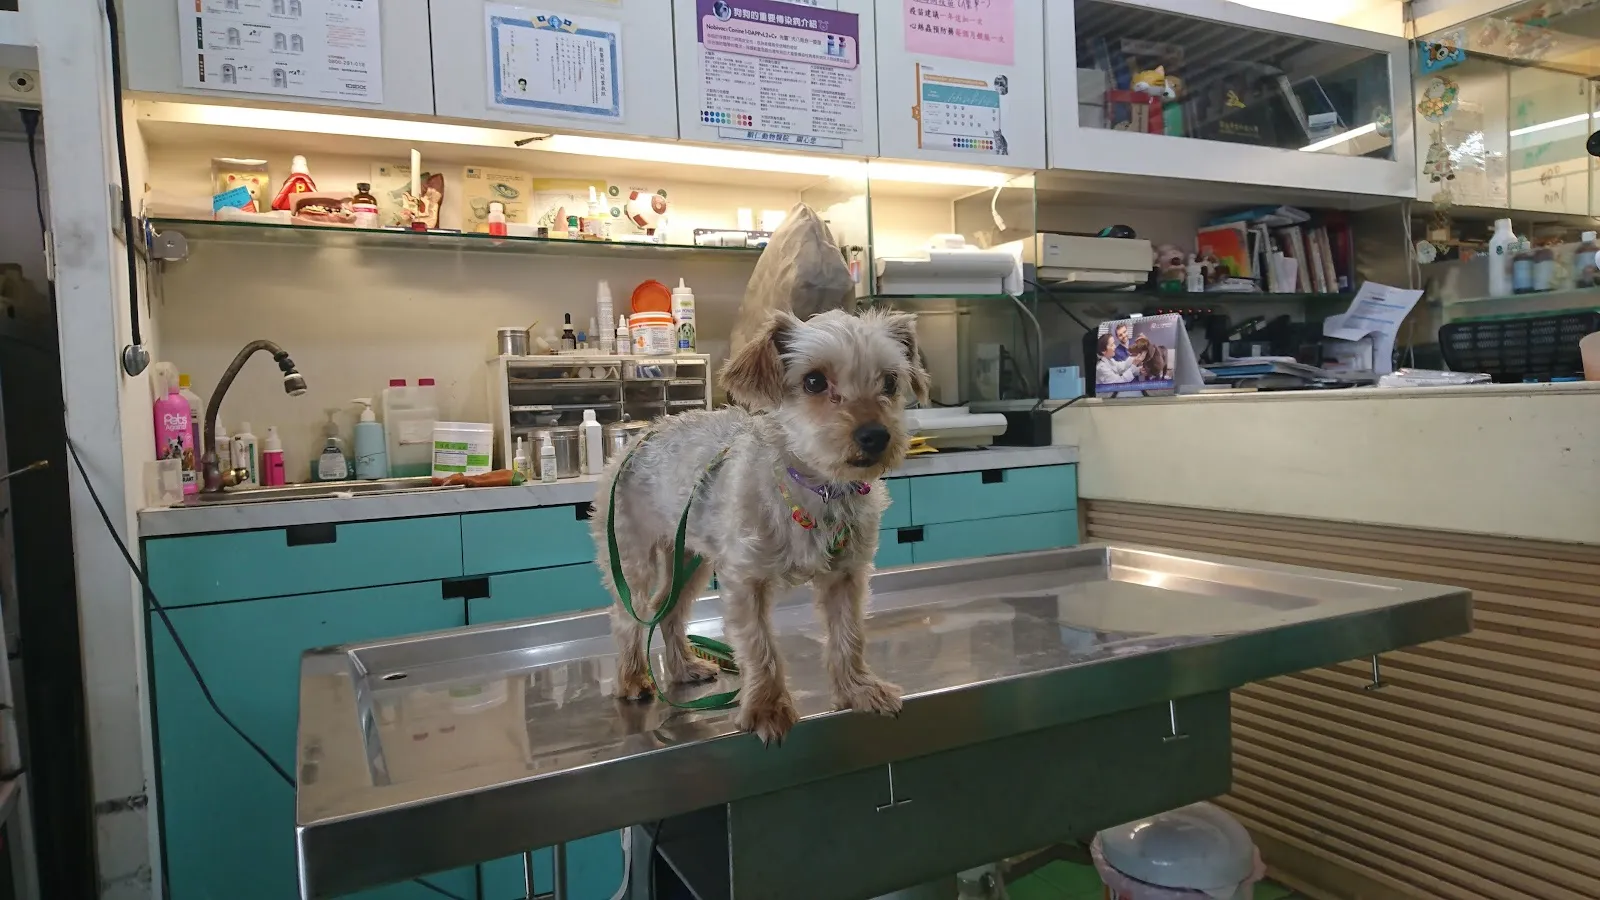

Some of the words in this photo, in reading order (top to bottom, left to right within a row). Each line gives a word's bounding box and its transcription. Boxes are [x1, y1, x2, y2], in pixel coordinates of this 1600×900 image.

[733, 7, 818, 29] 狗狗的重要傳染病介紹
[164, 413, 187, 426] Pets
